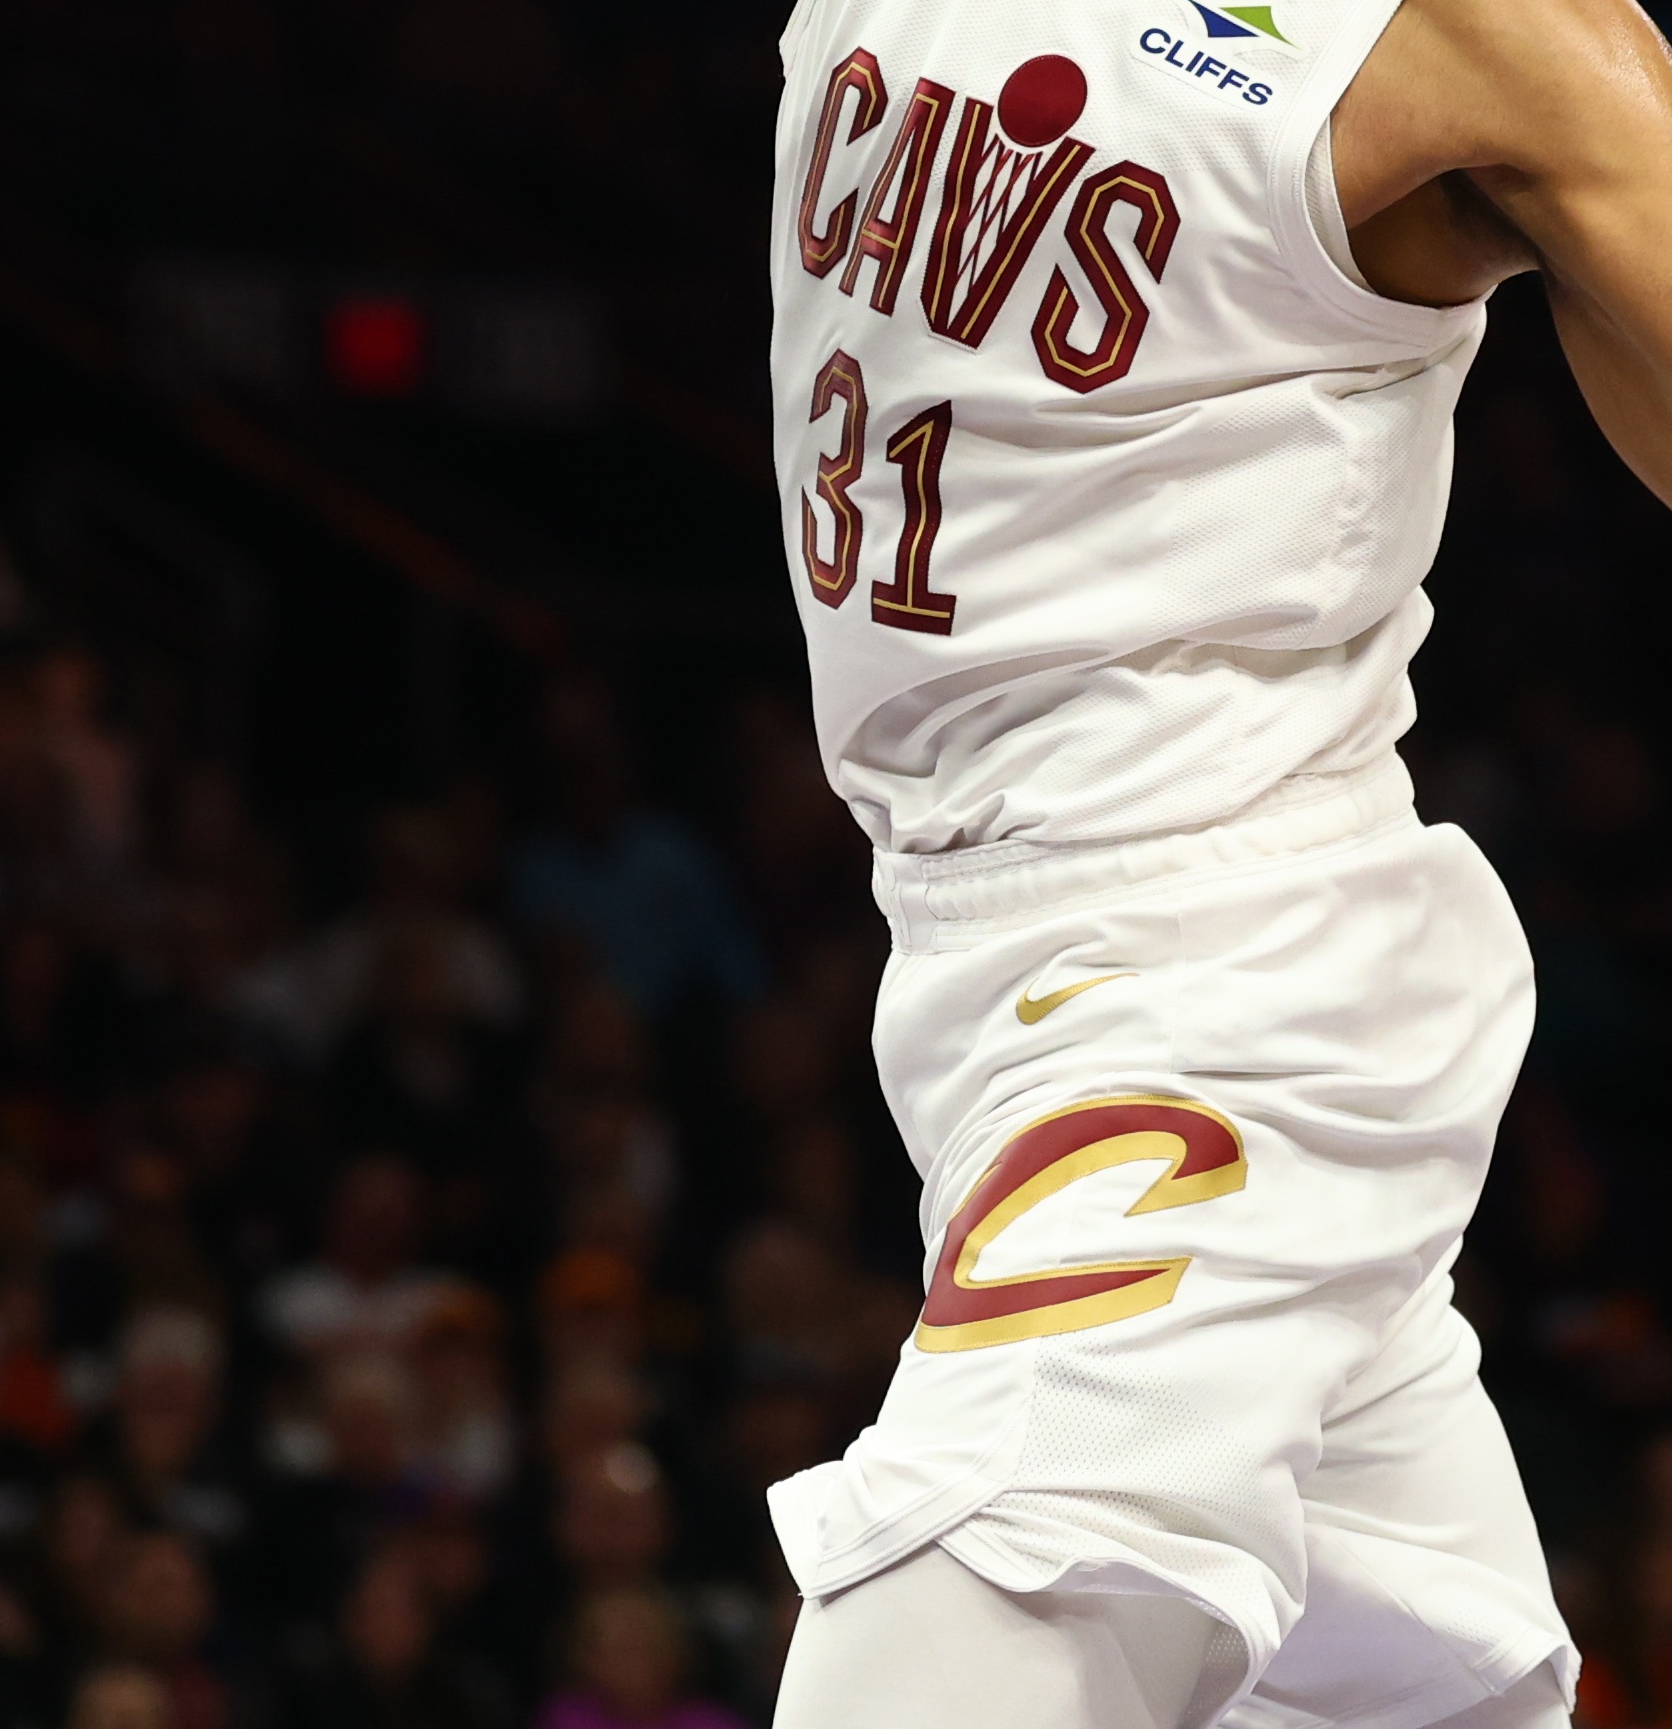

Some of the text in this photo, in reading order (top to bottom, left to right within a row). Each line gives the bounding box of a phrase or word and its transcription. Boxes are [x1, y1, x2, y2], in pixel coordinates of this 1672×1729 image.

[1139, 27, 1274, 106] CLIFFS
[797, 46, 1181, 393] CAVS
[801, 348, 957, 636] 31
[914, 1093, 1248, 1354] C
